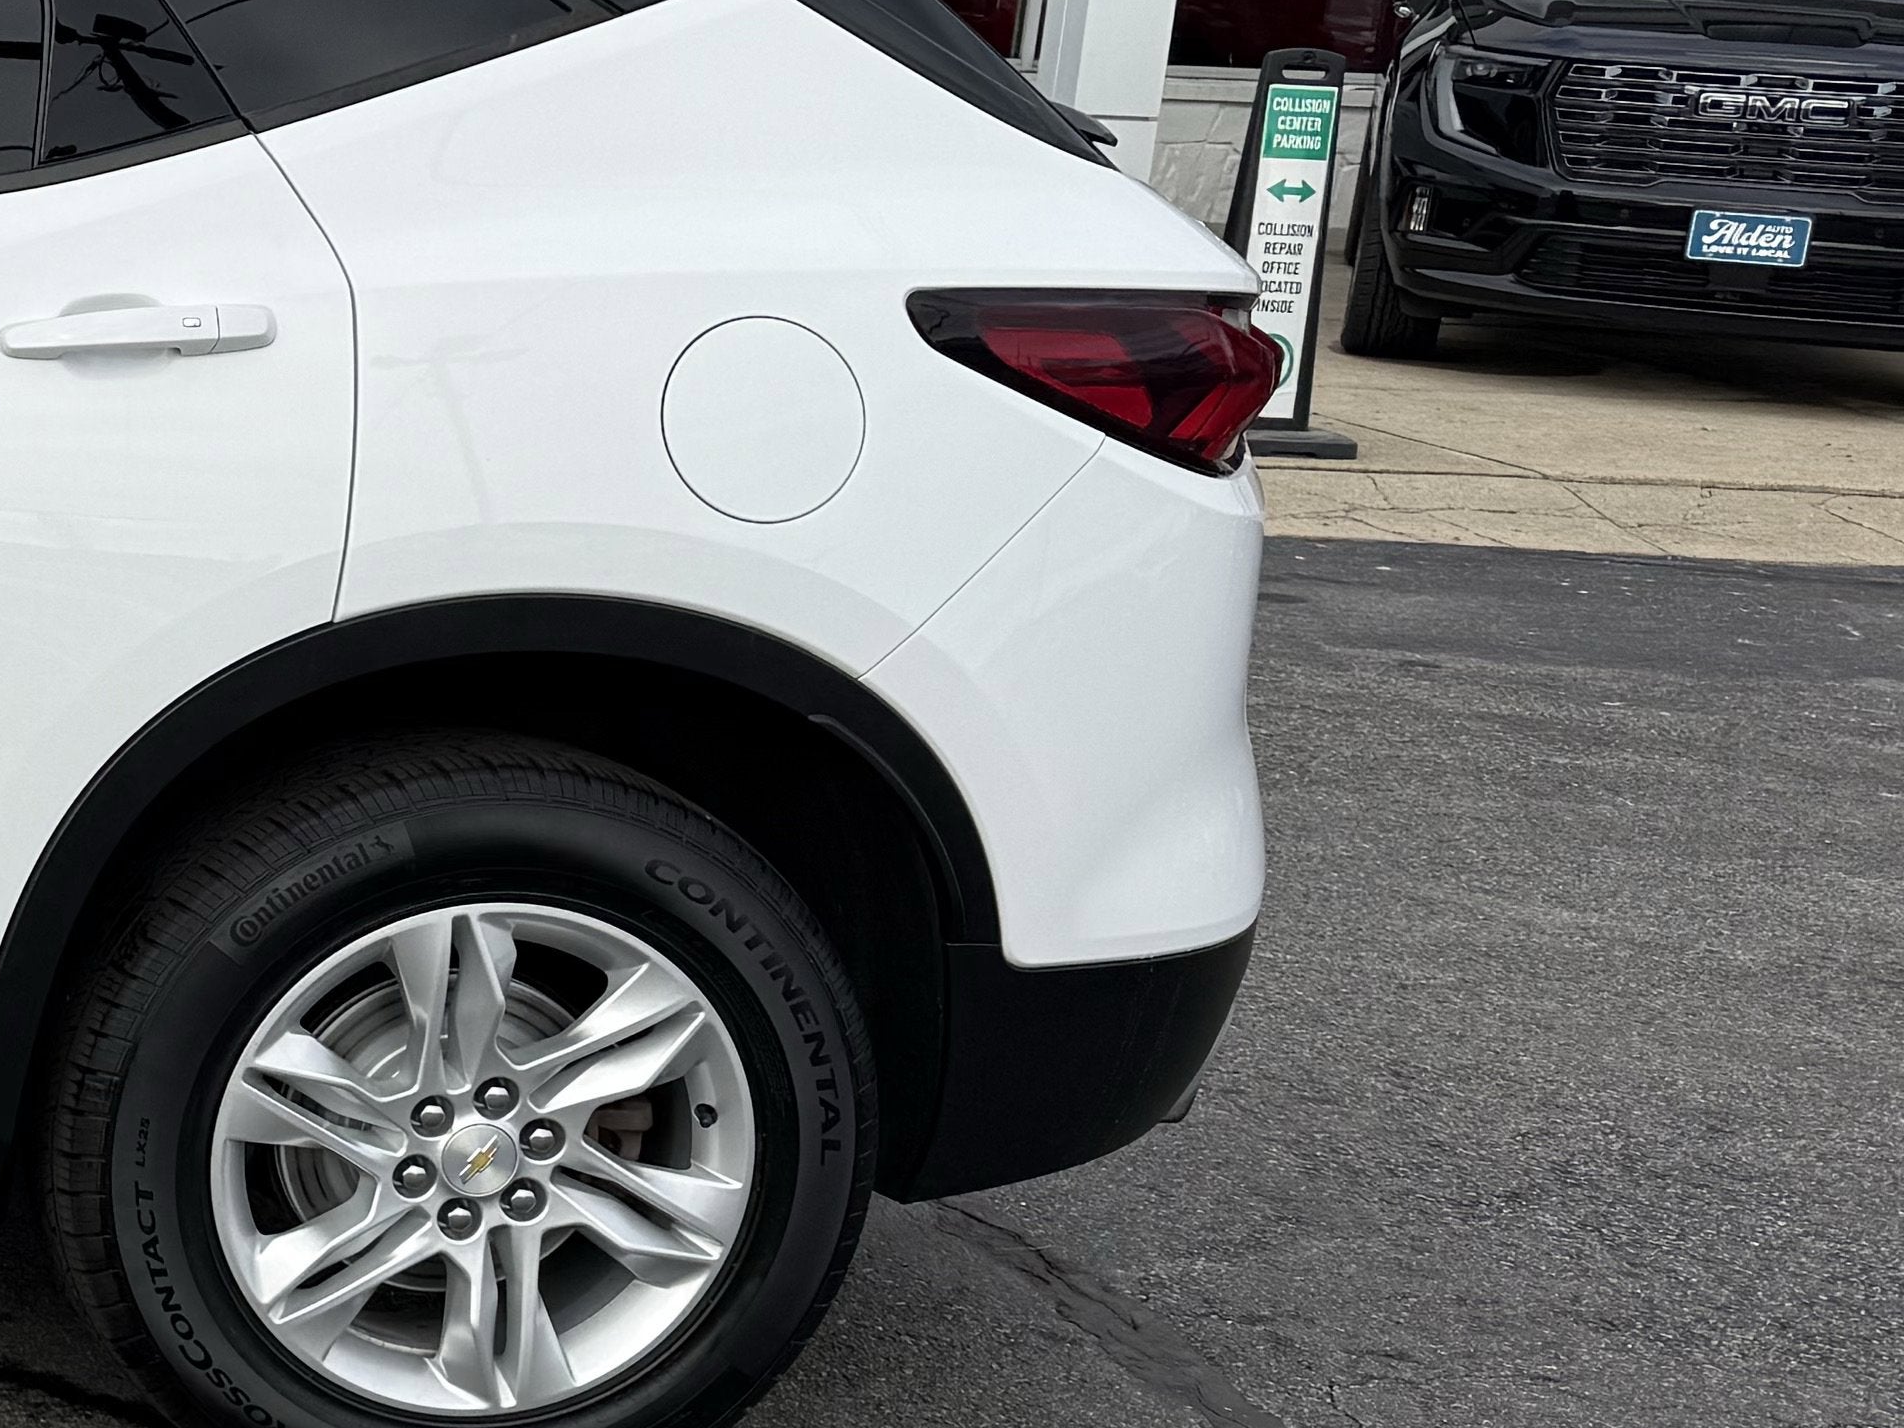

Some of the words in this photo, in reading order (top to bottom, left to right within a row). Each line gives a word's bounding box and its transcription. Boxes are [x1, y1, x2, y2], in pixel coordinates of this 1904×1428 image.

[1272, 97, 1331, 113] COLLISION
[1699, 92, 1850, 128] GMC
[1277, 116, 1322, 132] CENTER
[1272, 134, 1322, 150] PARKING
[1257, 222, 1314, 237] COLLISION
[1702, 219, 1796, 249] Alden
[1264, 242, 1304, 256] REPAIR
[1262, 261, 1301, 275] OFFICE
[1261, 280, 1302, 294] OCATED
[229, 842, 372, 947] Continental
[644, 859, 843, 1166] CONTINENTAL
